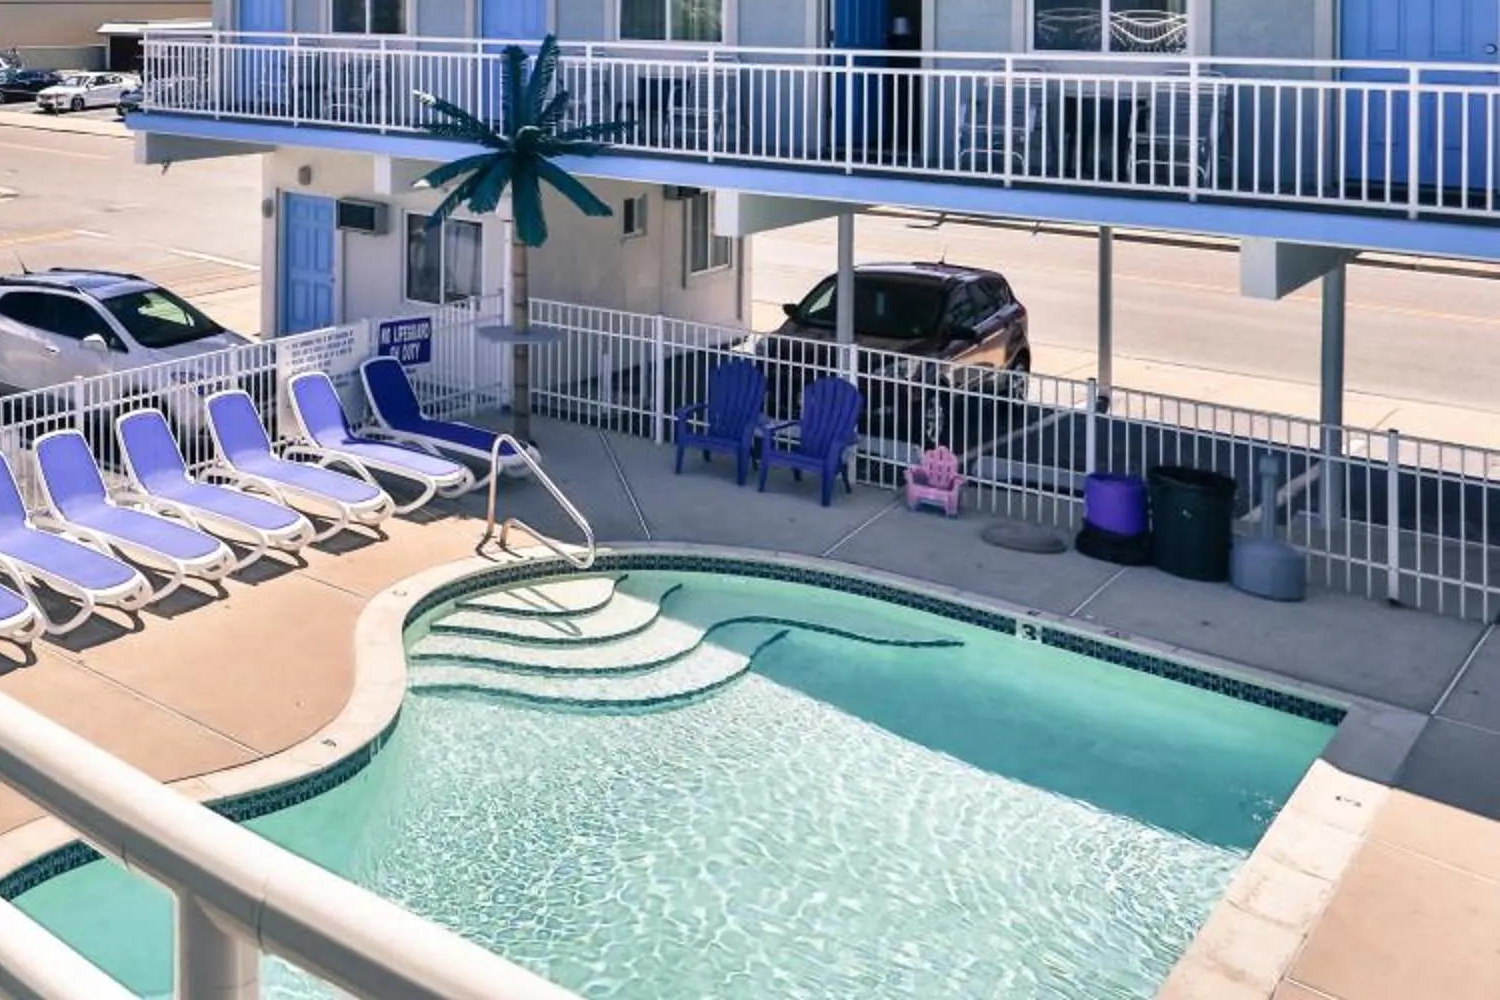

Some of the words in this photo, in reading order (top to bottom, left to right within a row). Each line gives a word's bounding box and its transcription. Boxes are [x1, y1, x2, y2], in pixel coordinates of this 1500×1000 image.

[381, 326, 391, 344] NO
[393, 322, 430, 343] LIFEGUARD
[401, 342, 420, 361] DUTY
[1021, 623, 1037, 641] 3
